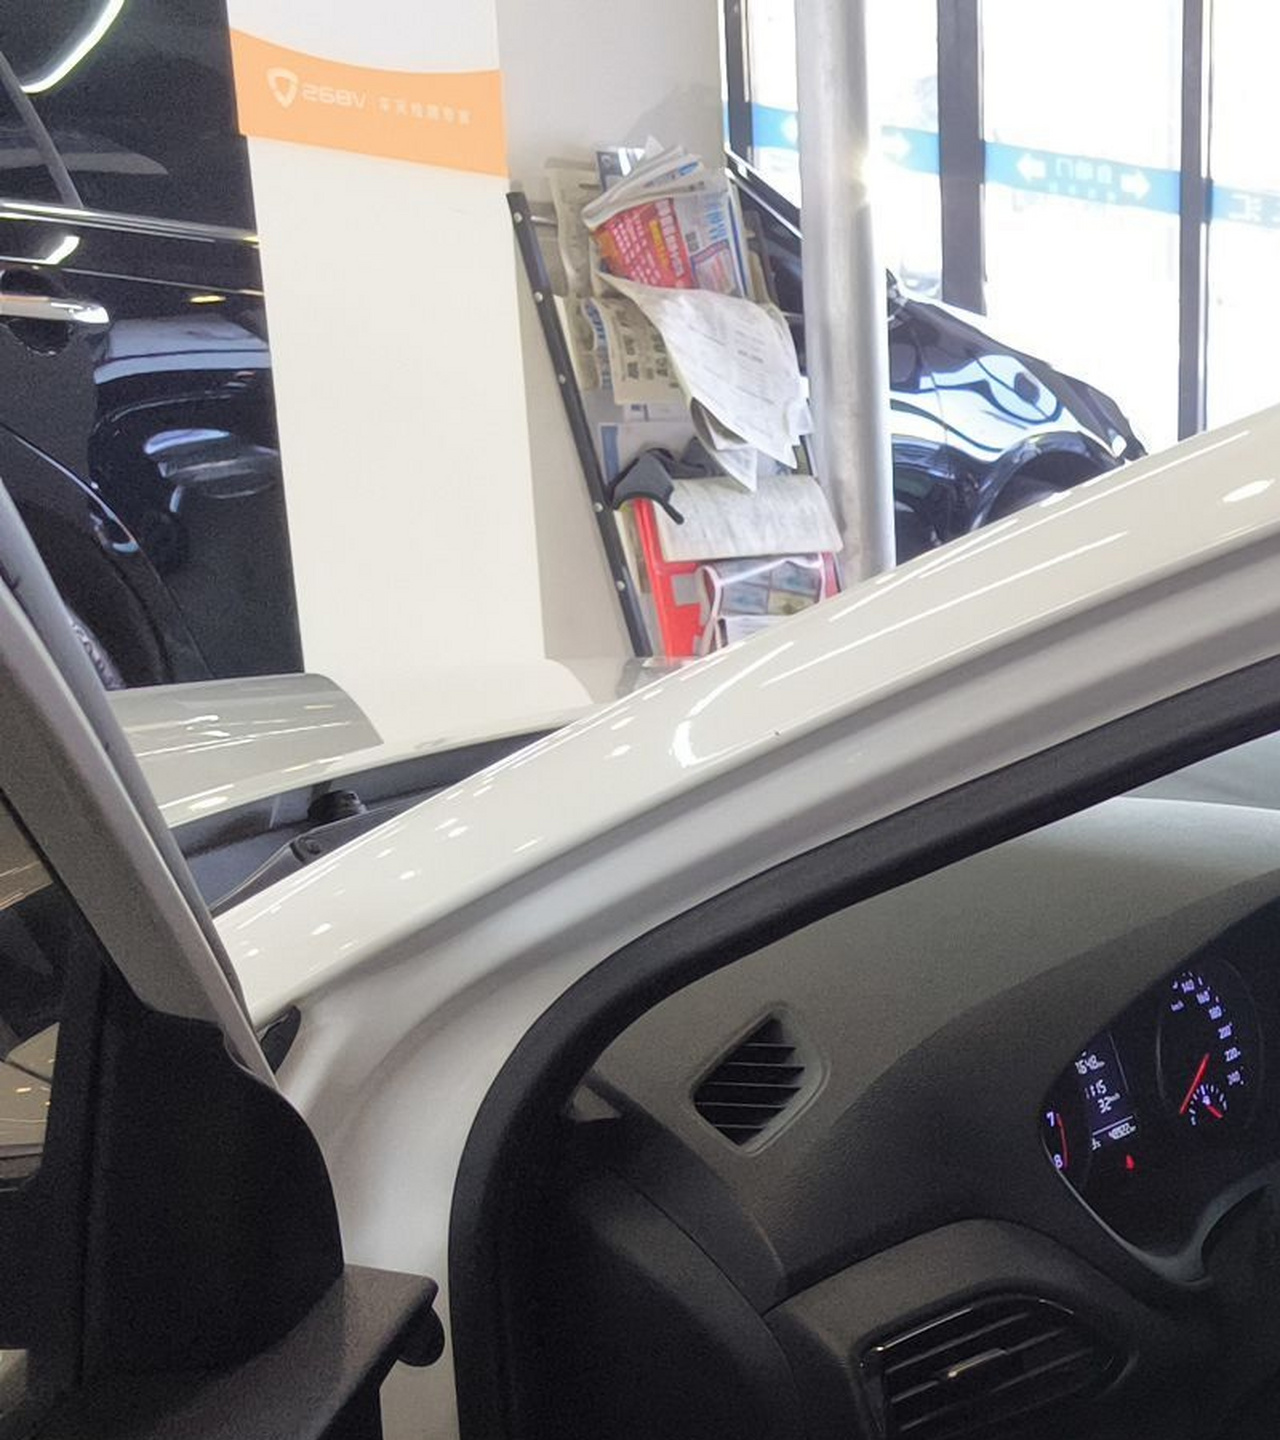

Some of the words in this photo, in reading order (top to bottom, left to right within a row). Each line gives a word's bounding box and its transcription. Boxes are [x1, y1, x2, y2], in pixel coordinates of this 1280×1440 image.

[301, 83, 368, 109] 268V
[1046, 1110, 1055, 1127] 7
[1053, 1153, 1063, 1169] 8
